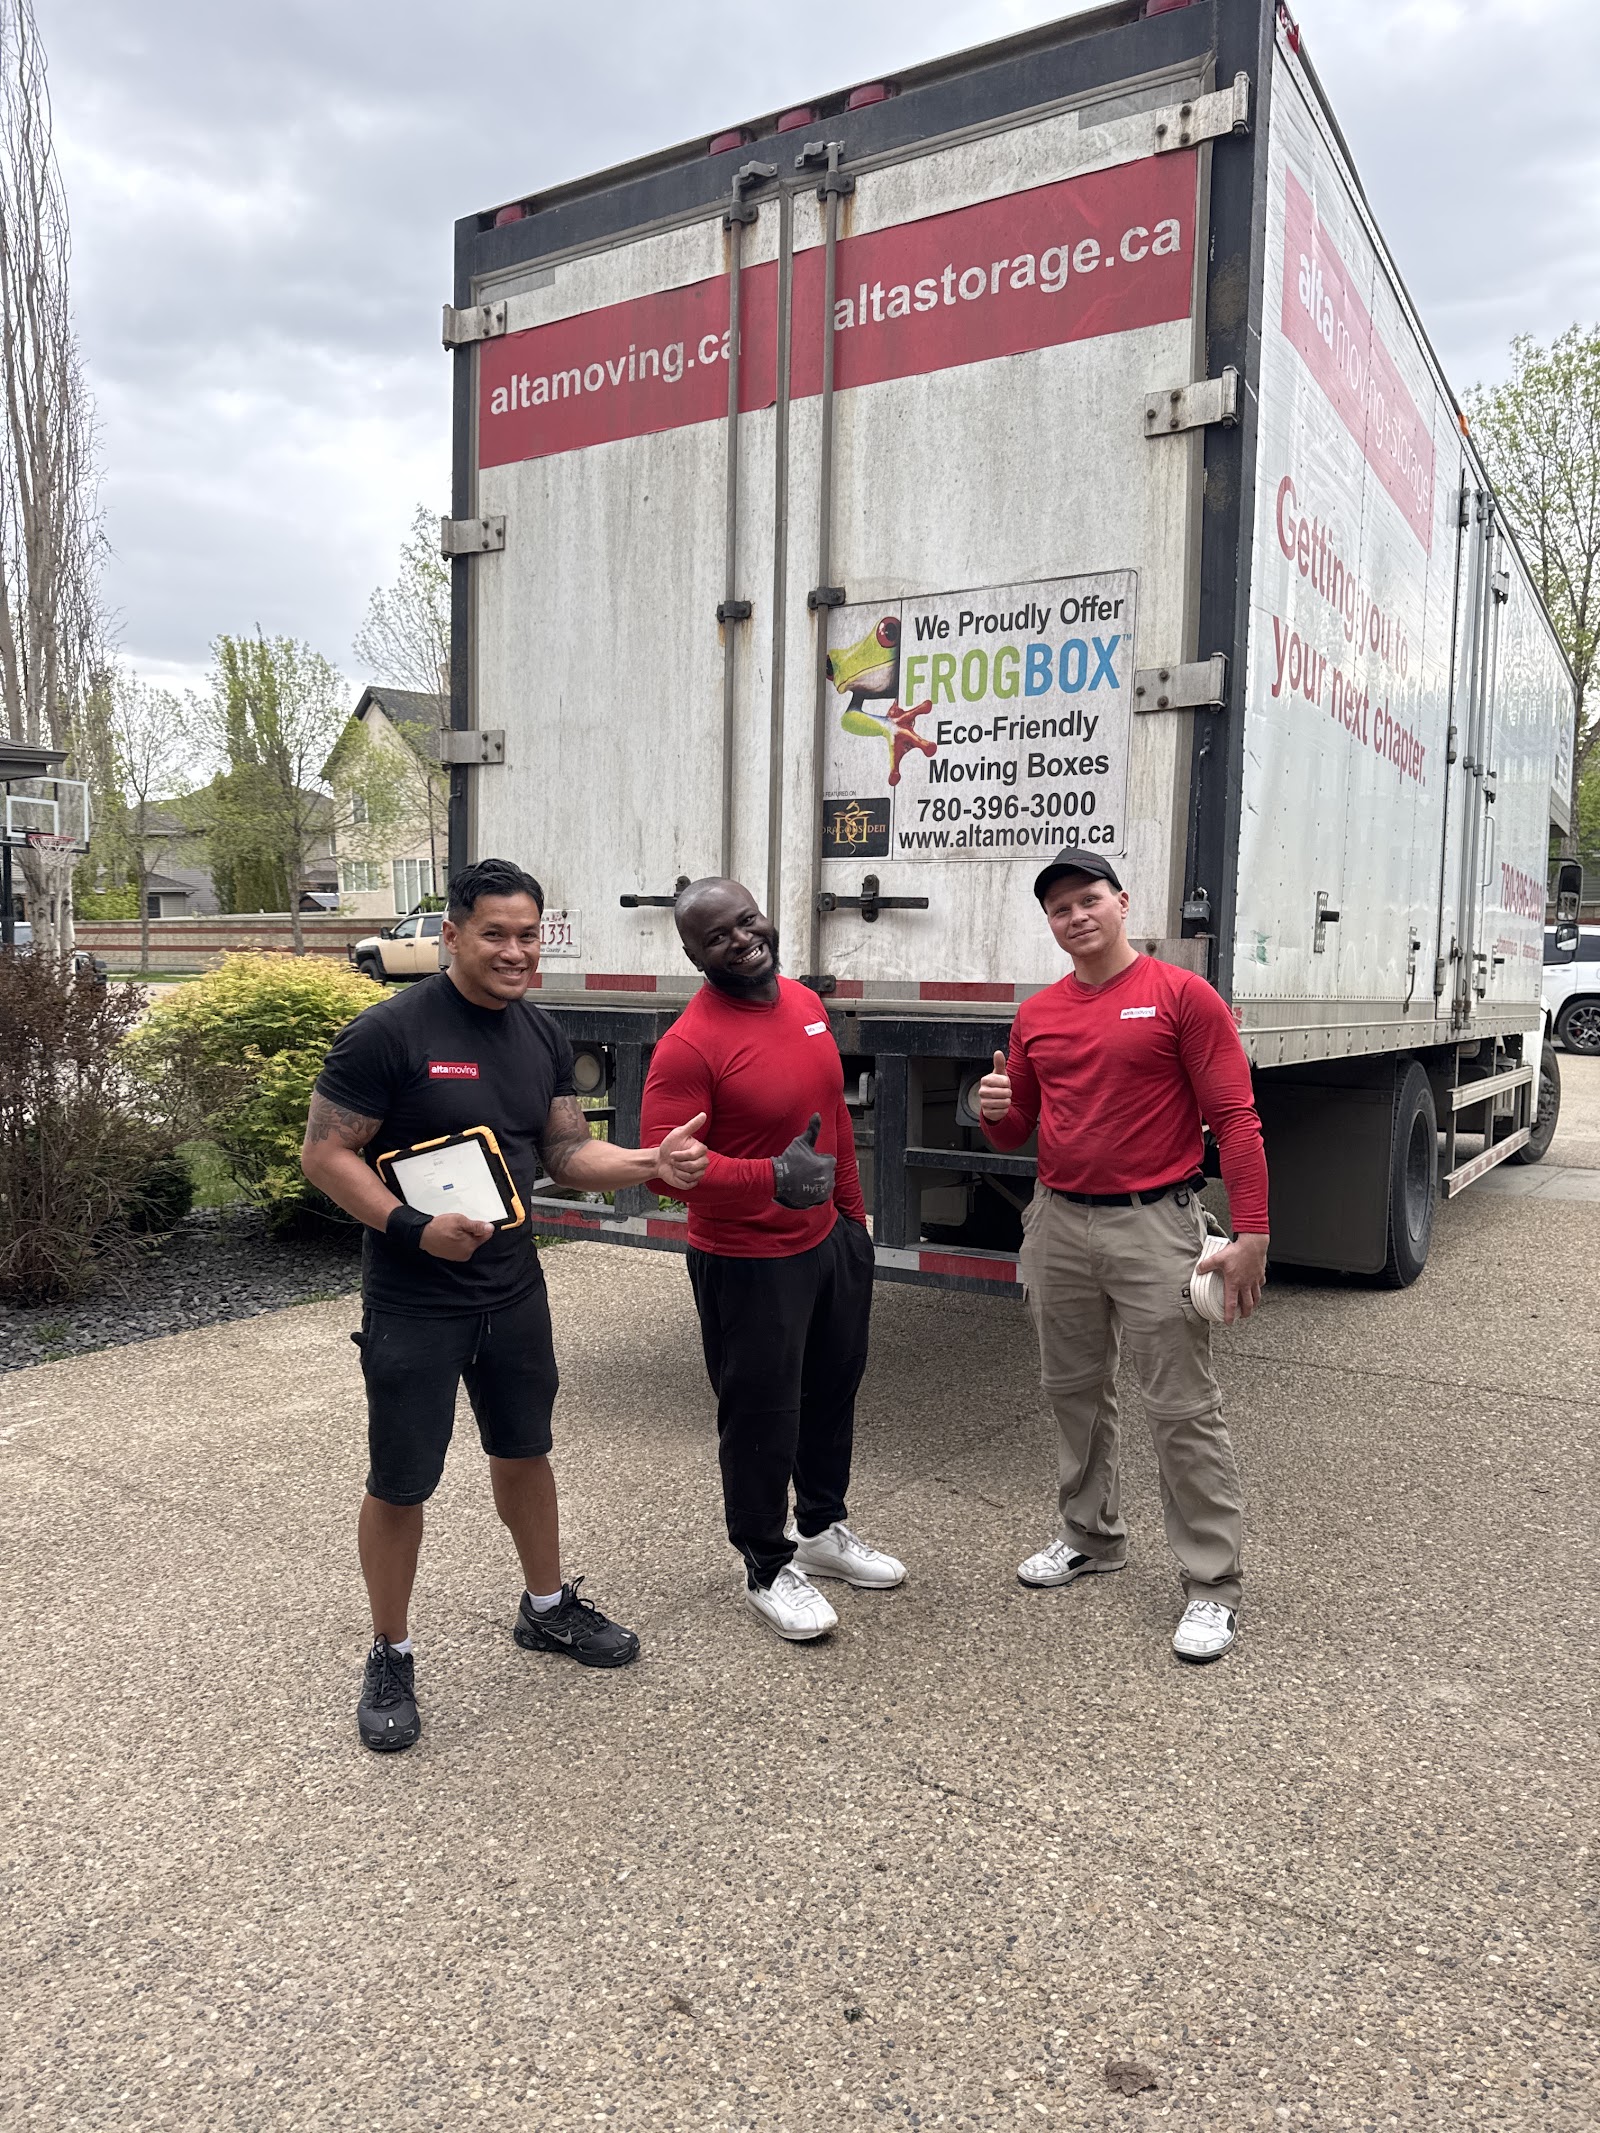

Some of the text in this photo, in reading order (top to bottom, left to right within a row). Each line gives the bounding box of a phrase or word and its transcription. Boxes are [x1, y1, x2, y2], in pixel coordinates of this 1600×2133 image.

[834, 218, 1182, 332] altastorage.ca
[491, 329, 742, 416] altamoving.ca
[1276, 475, 1408, 681] Getting you to
[914, 595, 1125, 641] We Proudly Offer
[905, 634, 1122, 707] FROGBOX
[936, 710, 1099, 746] Eco-Friendly
[1271, 615, 1427, 788] your next chapter.
[929, 752, 1110, 786] Moving Boxes
[899, 820, 1116, 849] www.altamoving.ca
[917, 790, 1096, 823] 780-396-3000
